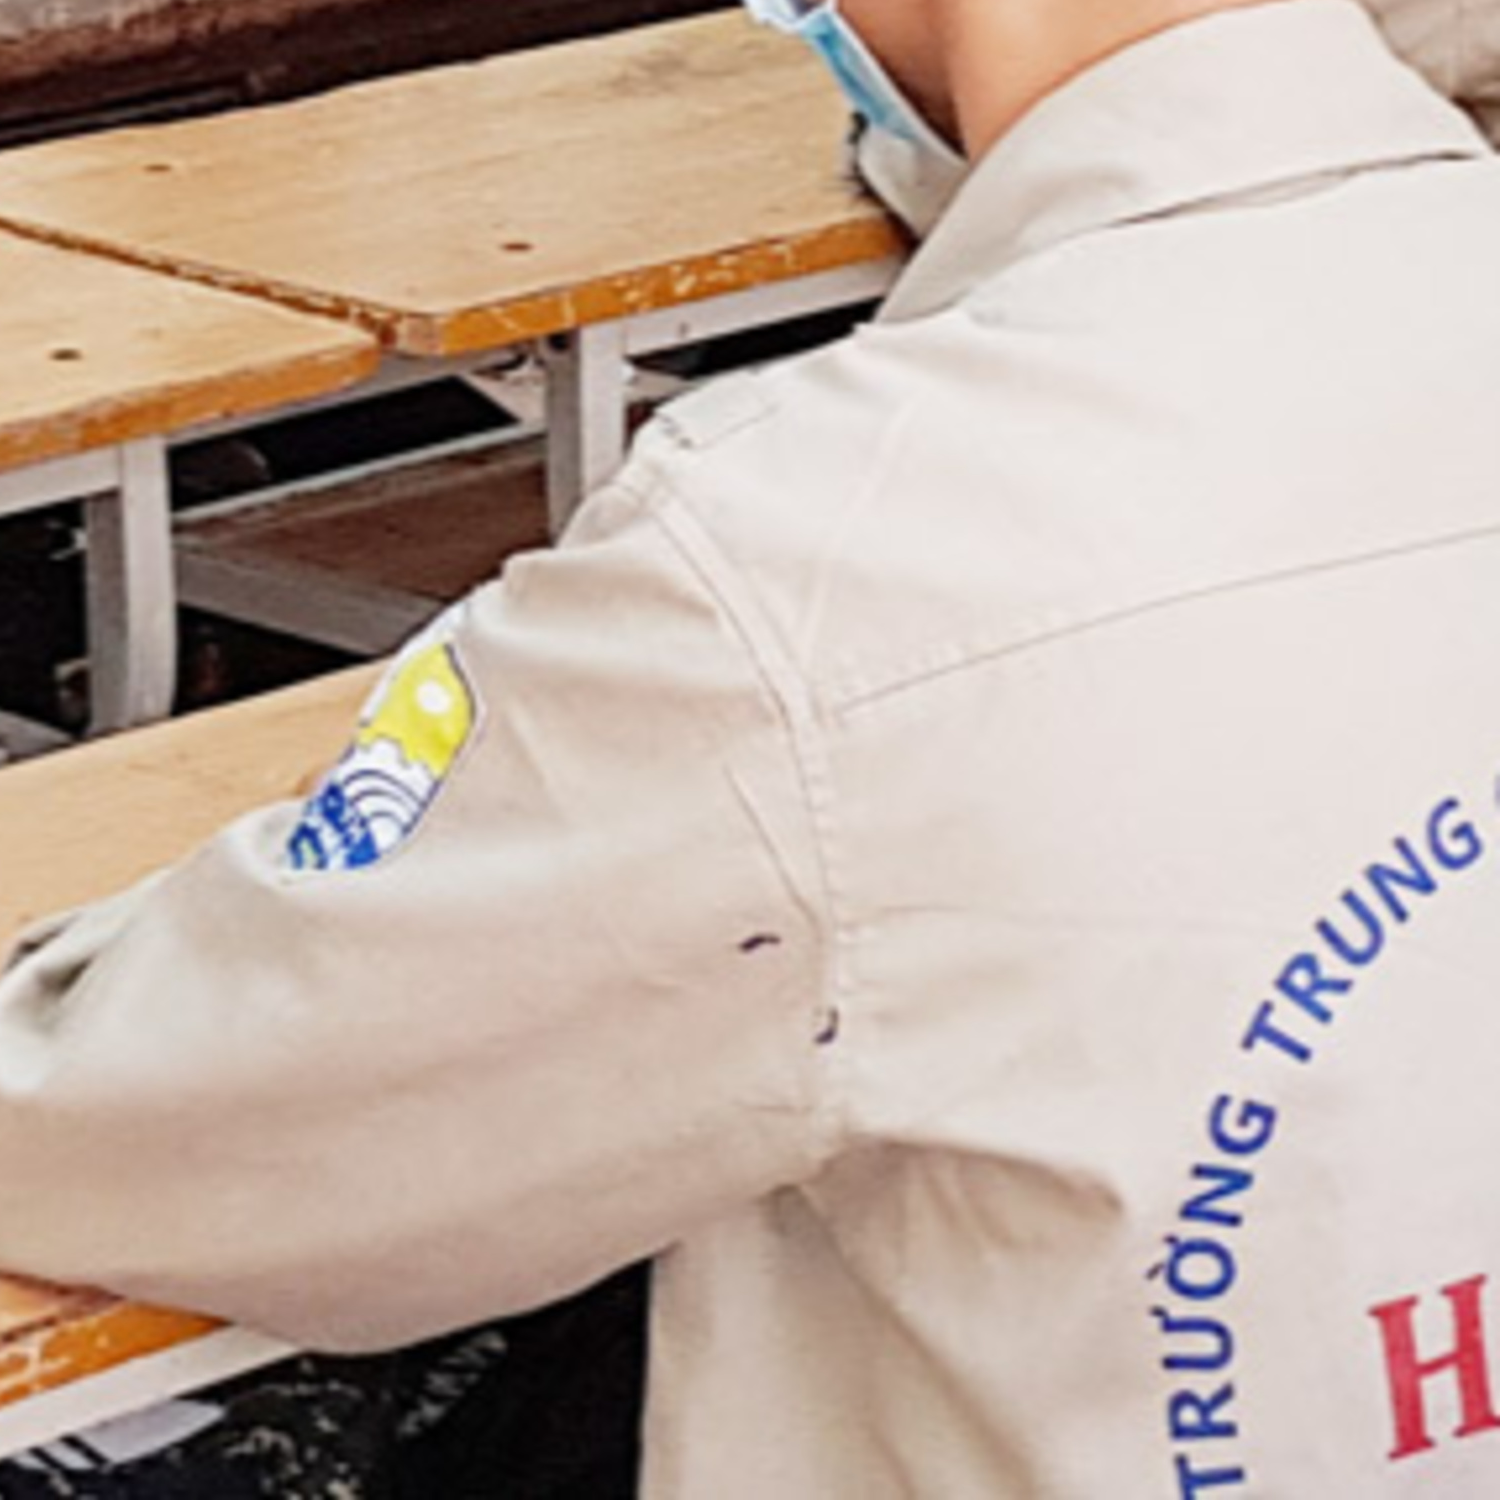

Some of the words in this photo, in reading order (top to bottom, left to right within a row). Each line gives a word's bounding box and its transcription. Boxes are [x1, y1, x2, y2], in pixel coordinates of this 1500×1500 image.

[1147, 1093, 1278, 1500] TRƯỜNG
[1241, 796, 1484, 1064] TRUNG
[1368, 1272, 1500, 1462] H
